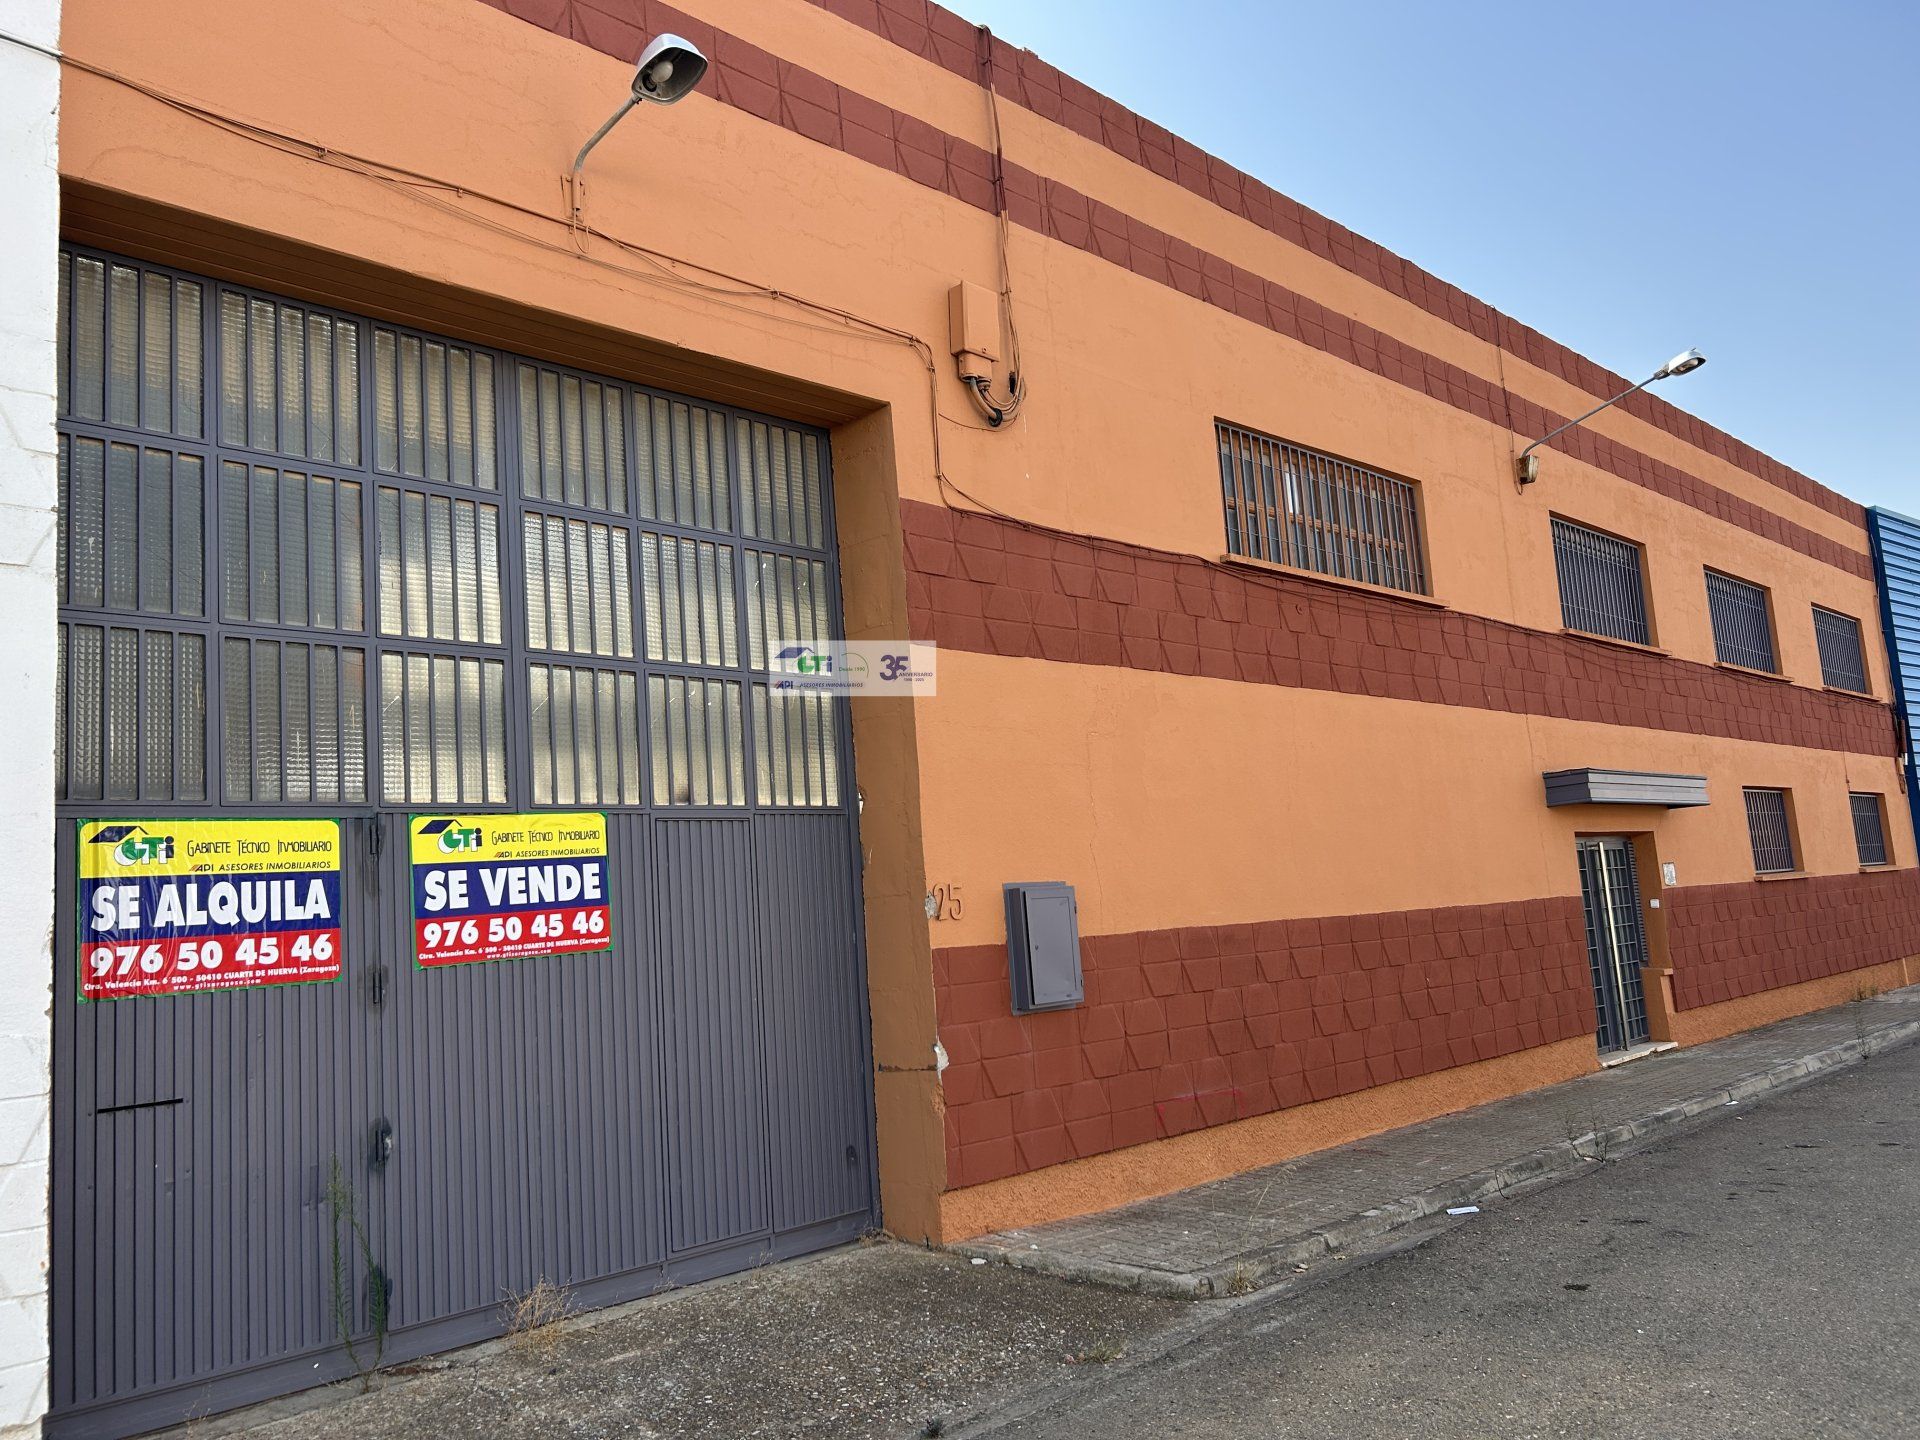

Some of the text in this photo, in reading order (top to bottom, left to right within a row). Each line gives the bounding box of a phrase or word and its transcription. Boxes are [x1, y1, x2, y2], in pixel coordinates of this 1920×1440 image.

[187, 838, 332, 857] GABINETE TÉCNICO INMOBILIARIO
[492, 829, 600, 846] GABINETE TÉCNICO INMOBILIARIO
[218, 862, 264, 872] ASESORES
[265, 860, 331, 871] INMOBILIARIOS
[515, 850, 549, 858] ASESORES
[550, 847, 600, 857] INMOBILIARIOS
[424, 863, 602, 912] SE VENDE
[91, 879, 331, 932] SE ALQUILA
[932, 883, 964, 921] 25
[423, 910, 605, 949] 976 50 45 46
[90, 933, 334, 977] 976 50 45 46
[419, 952, 435, 960] Ctra.
[436, 950, 464, 959] Valencia
[523, 942, 546, 950] CUARTE
[547, 940, 555, 948] DE
[555, 939, 579, 947] HUERVA
[84, 982, 103, 991] Ctra.
[105, 979, 142, 989] Valencia
[196, 973, 222, 982] 50410
[224, 970, 253, 980] CUARTE
[255, 969, 266, 977] DE
[267, 967, 298, 976] HUERVA
[299, 964, 340, 976] (Zaragoza)
